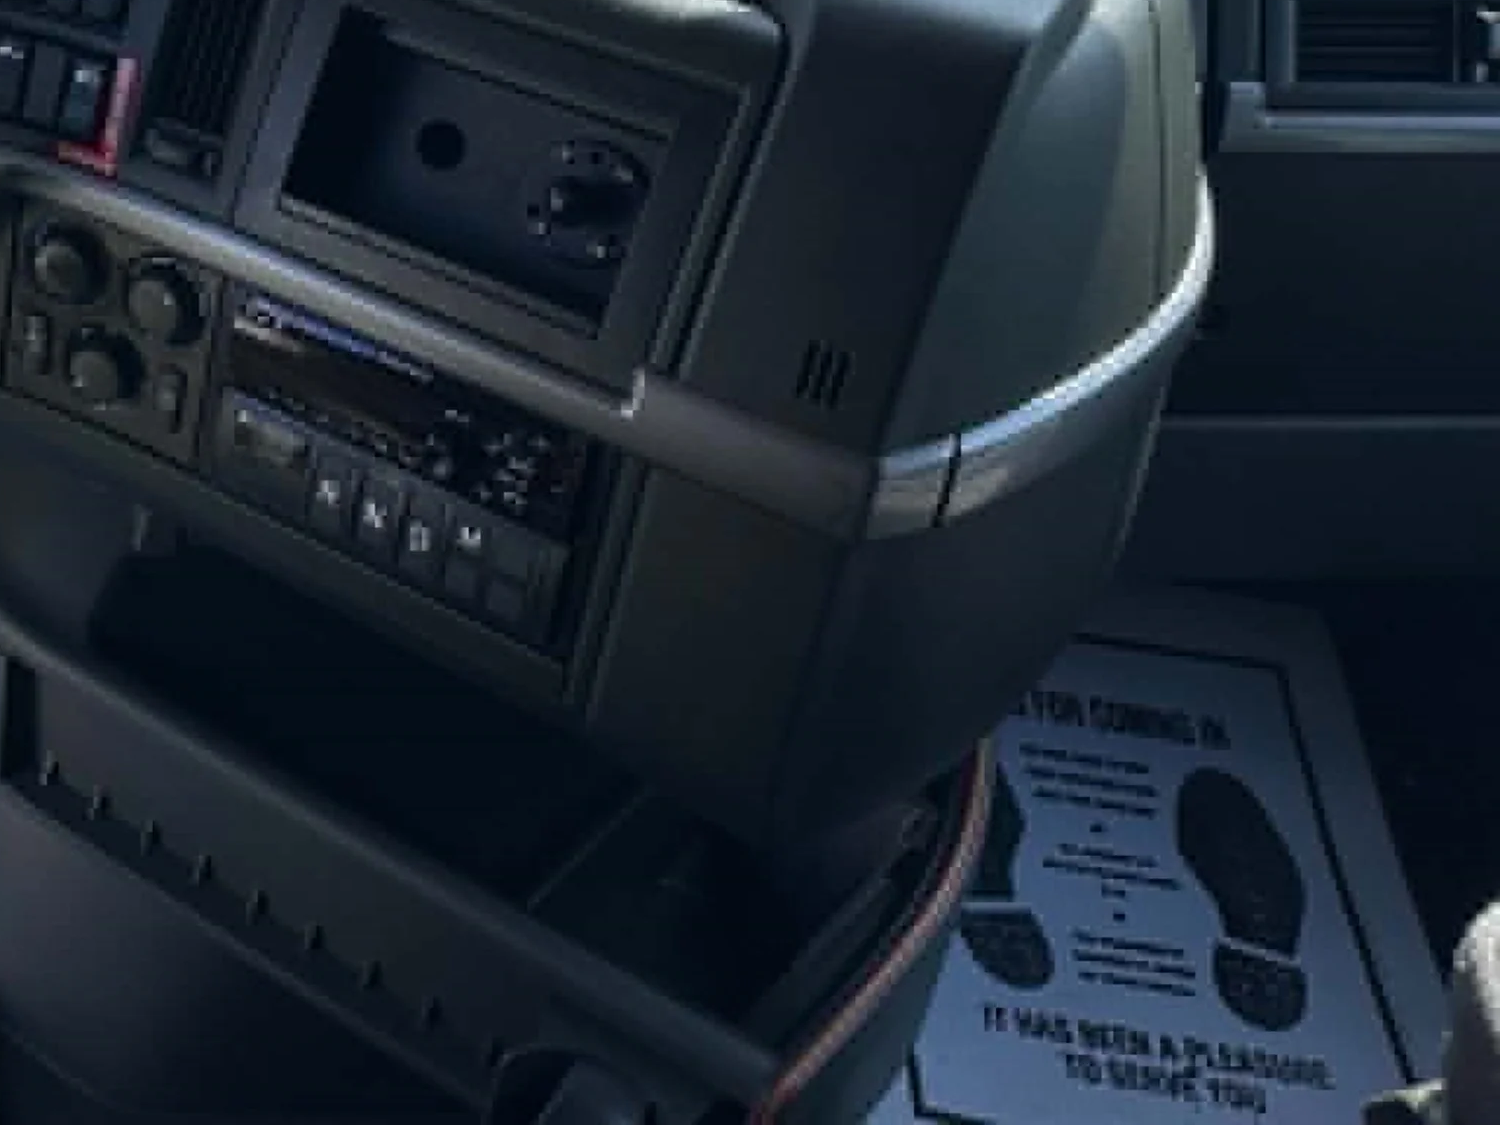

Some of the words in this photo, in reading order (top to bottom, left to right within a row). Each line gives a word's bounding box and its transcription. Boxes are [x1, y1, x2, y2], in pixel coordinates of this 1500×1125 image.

[982, 1004, 1009, 1032] IT
[1014, 1007, 1074, 1045] WAS
[1063, 1051, 1103, 1085] TO
[1206, 1075, 1269, 1114] YOU
